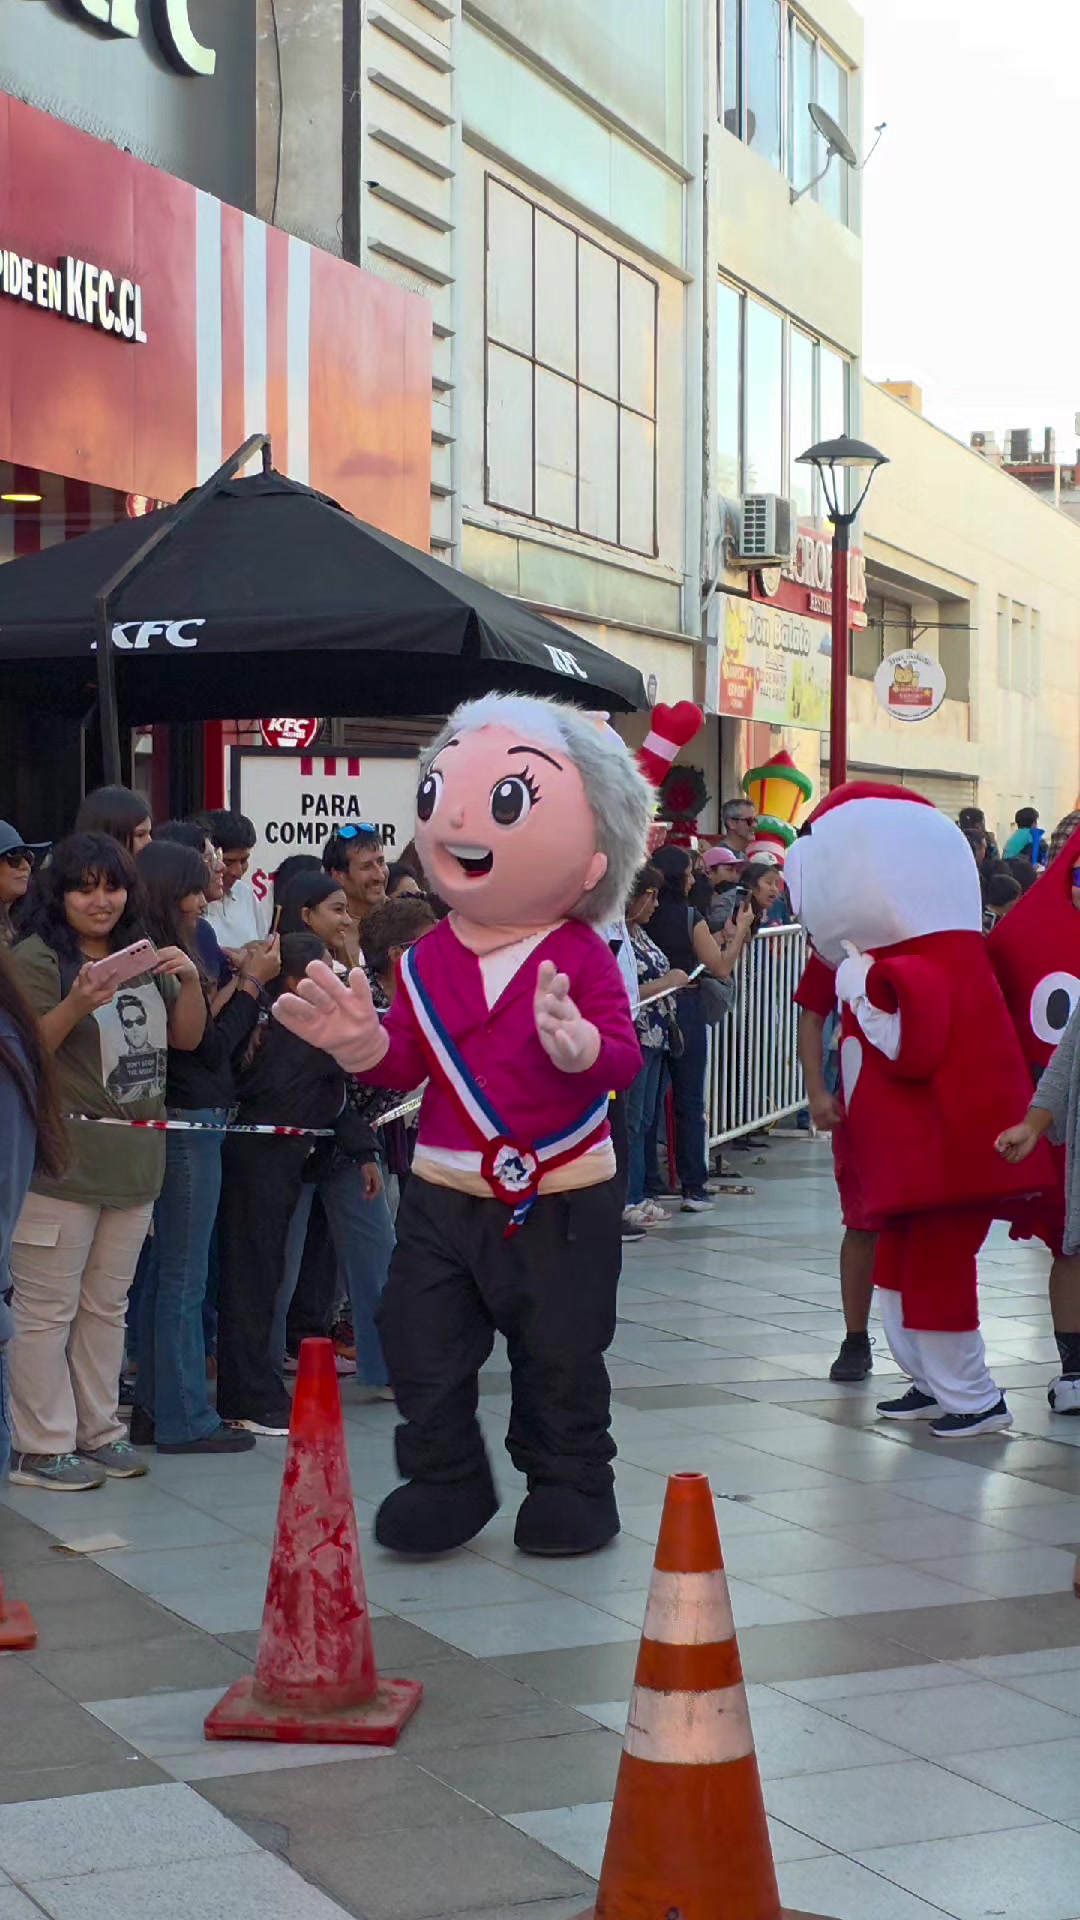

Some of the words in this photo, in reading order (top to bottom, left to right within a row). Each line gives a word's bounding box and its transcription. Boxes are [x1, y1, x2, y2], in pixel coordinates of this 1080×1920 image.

[37, 263, 61, 311] EN
[67, 255, 148, 344] KFC.CL
[542, 643, 588, 679] KFC
[267, 717, 310, 734] KFC
[301, 793, 361, 817] PARA
